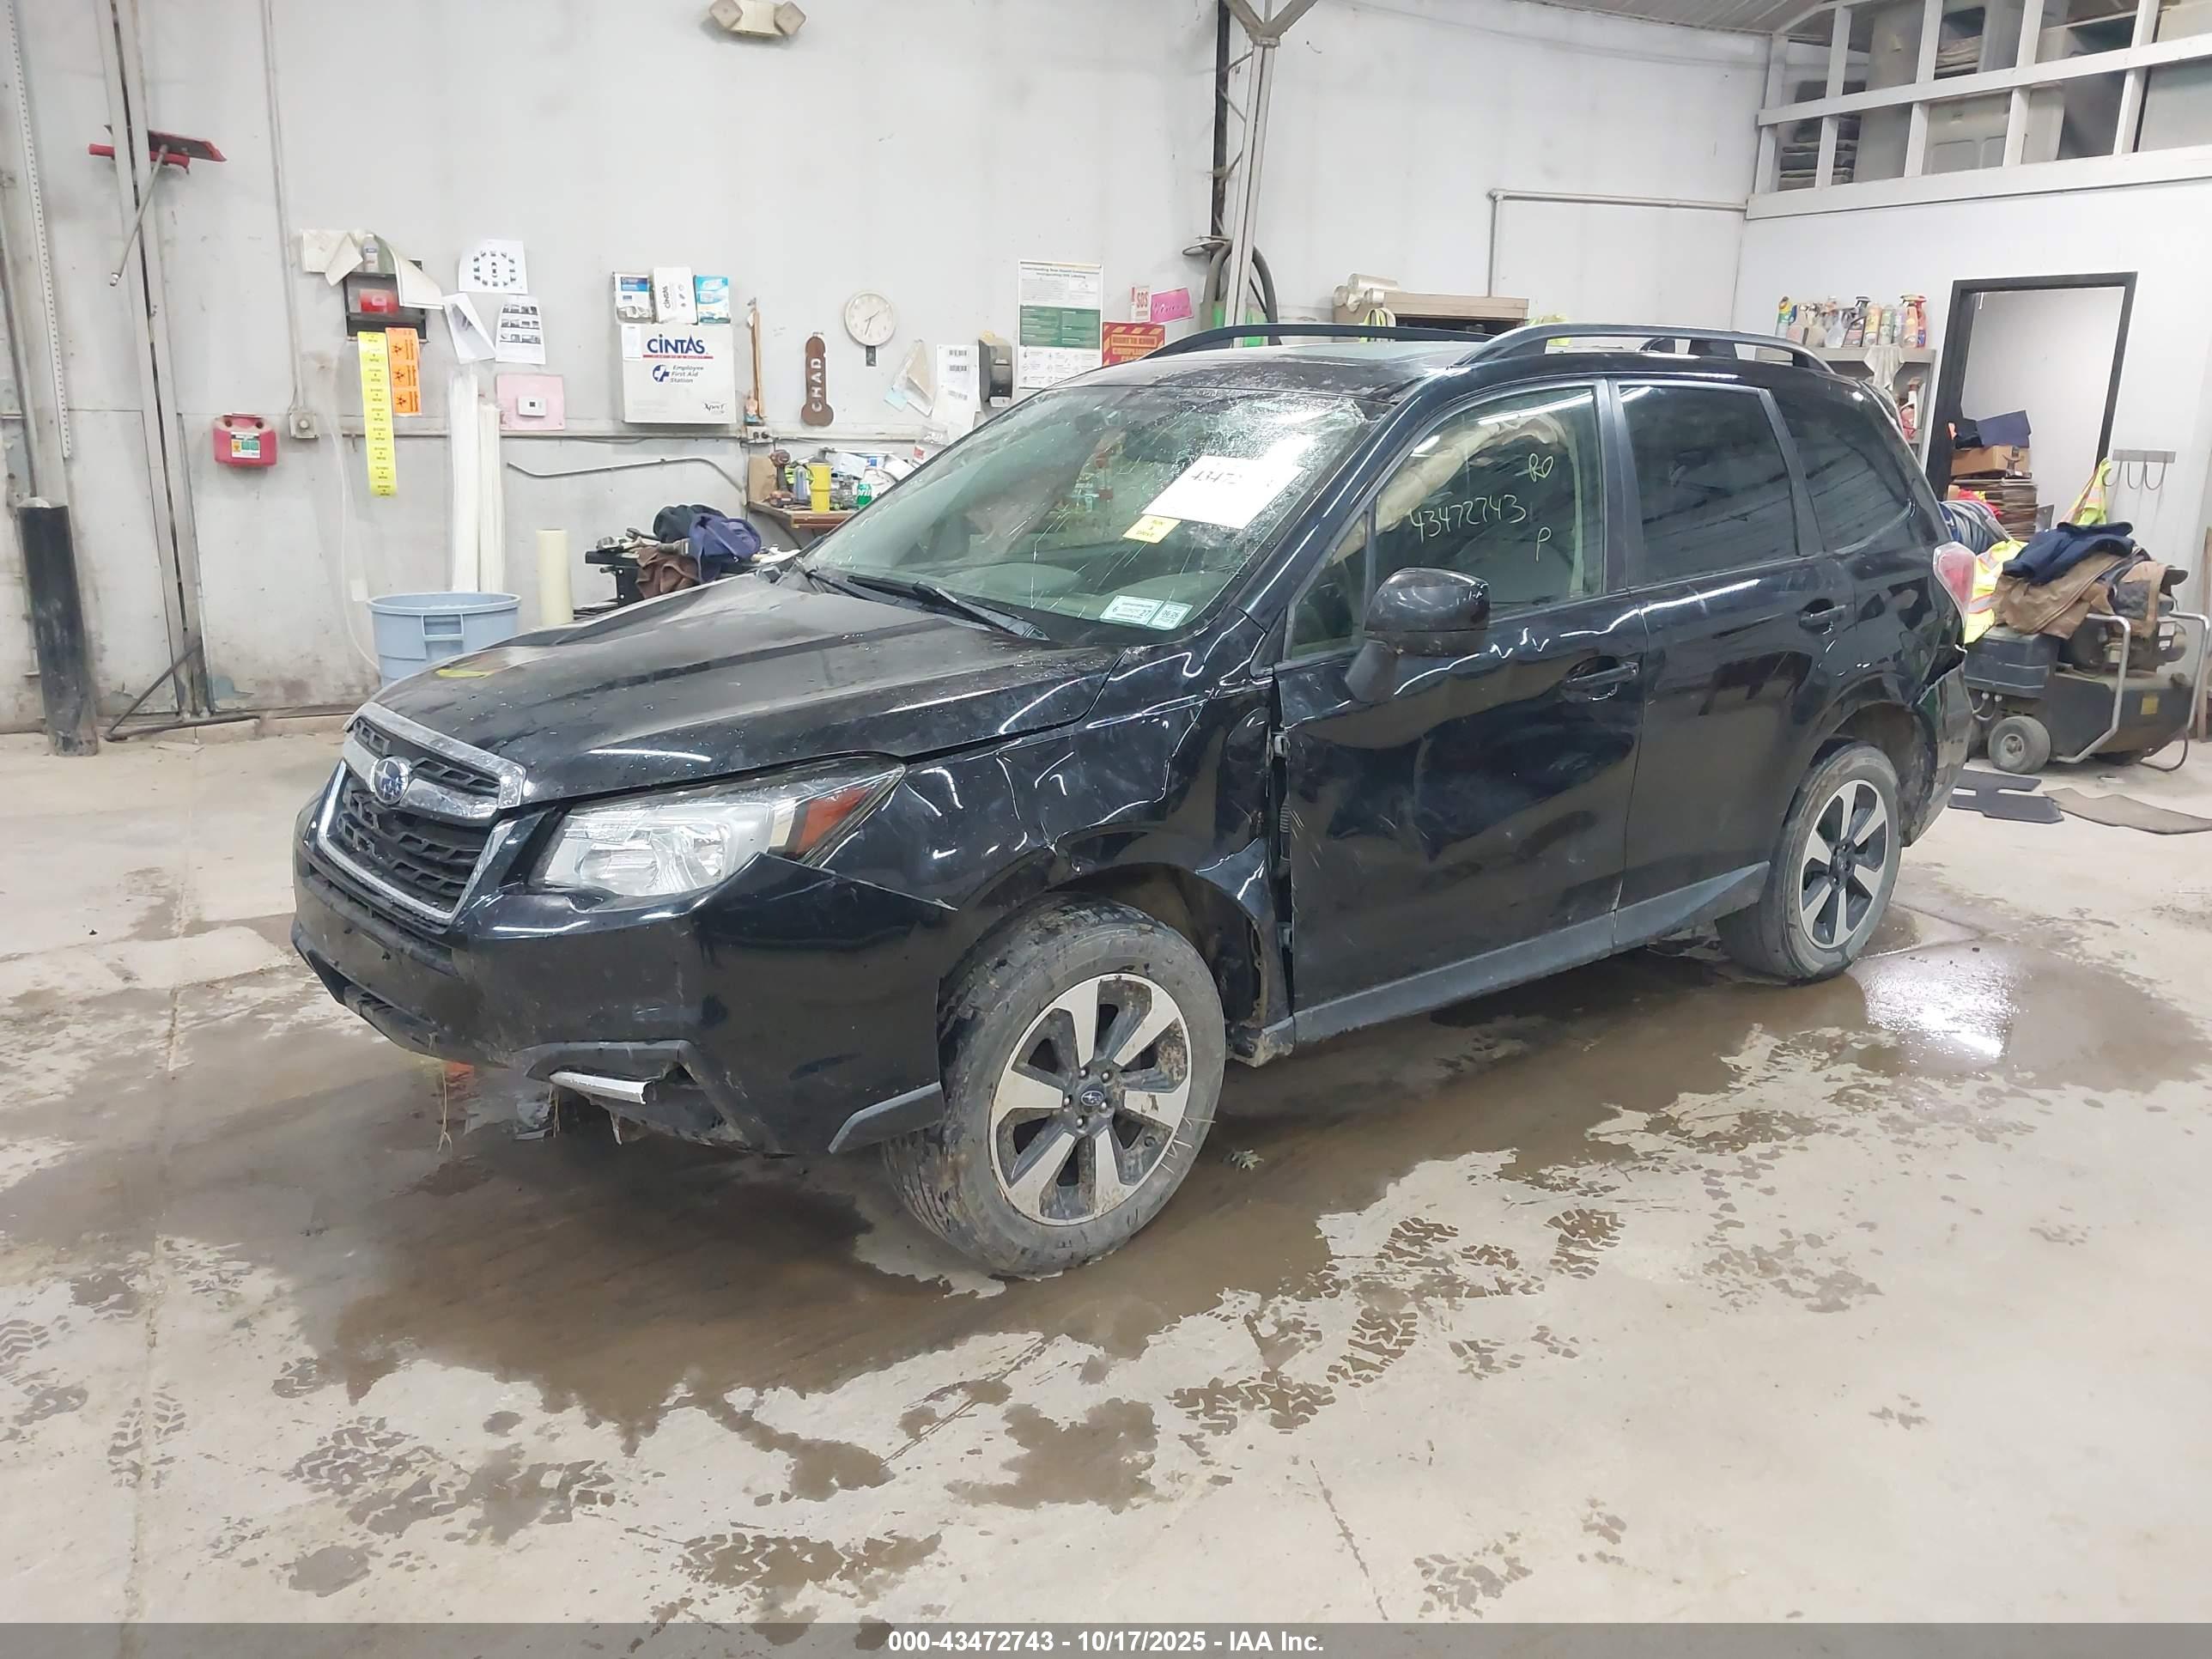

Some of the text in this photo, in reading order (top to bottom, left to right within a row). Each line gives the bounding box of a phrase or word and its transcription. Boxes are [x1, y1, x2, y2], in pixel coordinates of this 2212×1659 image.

[647, 333, 706, 355] CINTAS
[811, 357, 823, 413] CHAD
[1409, 494, 1527, 544] 43472743
